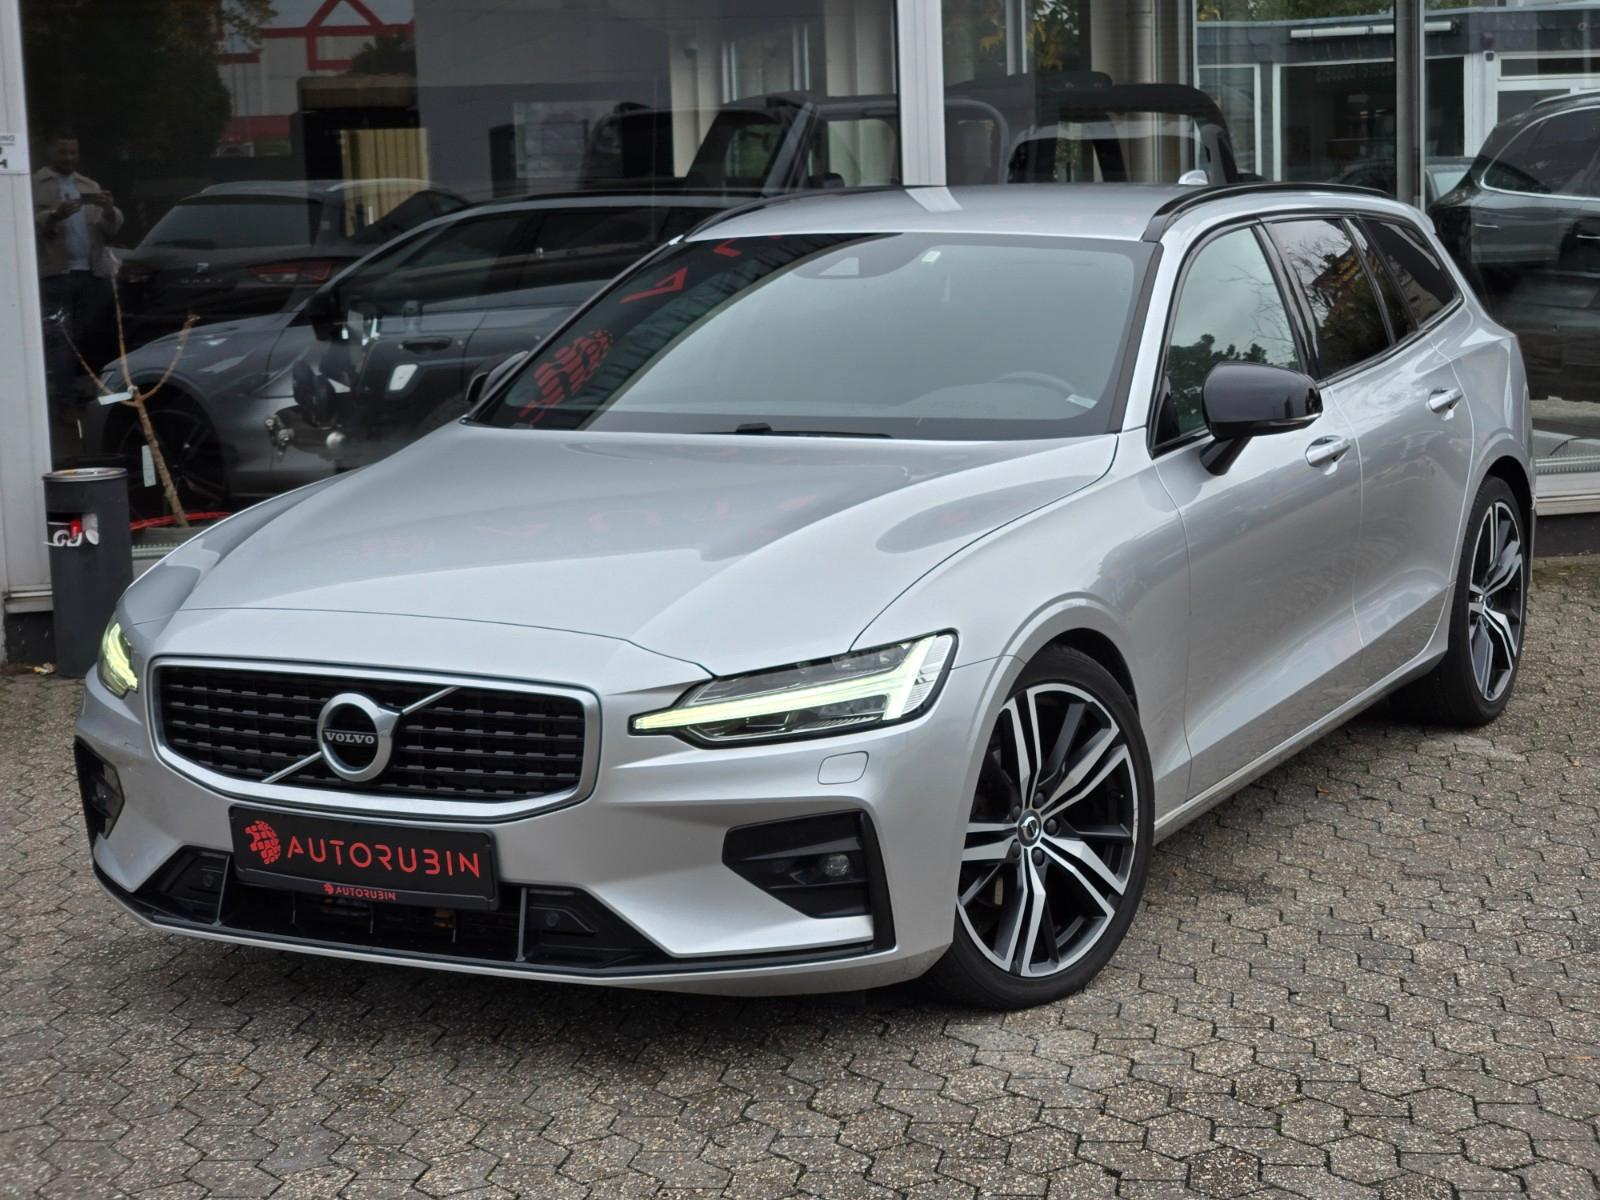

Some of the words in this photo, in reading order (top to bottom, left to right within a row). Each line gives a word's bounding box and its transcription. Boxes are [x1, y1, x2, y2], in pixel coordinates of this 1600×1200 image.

[324, 732, 375, 744] VOLVO
[287, 836, 480, 878] AUTORUBIN
[336, 887, 396, 900] AUTORUBIN
